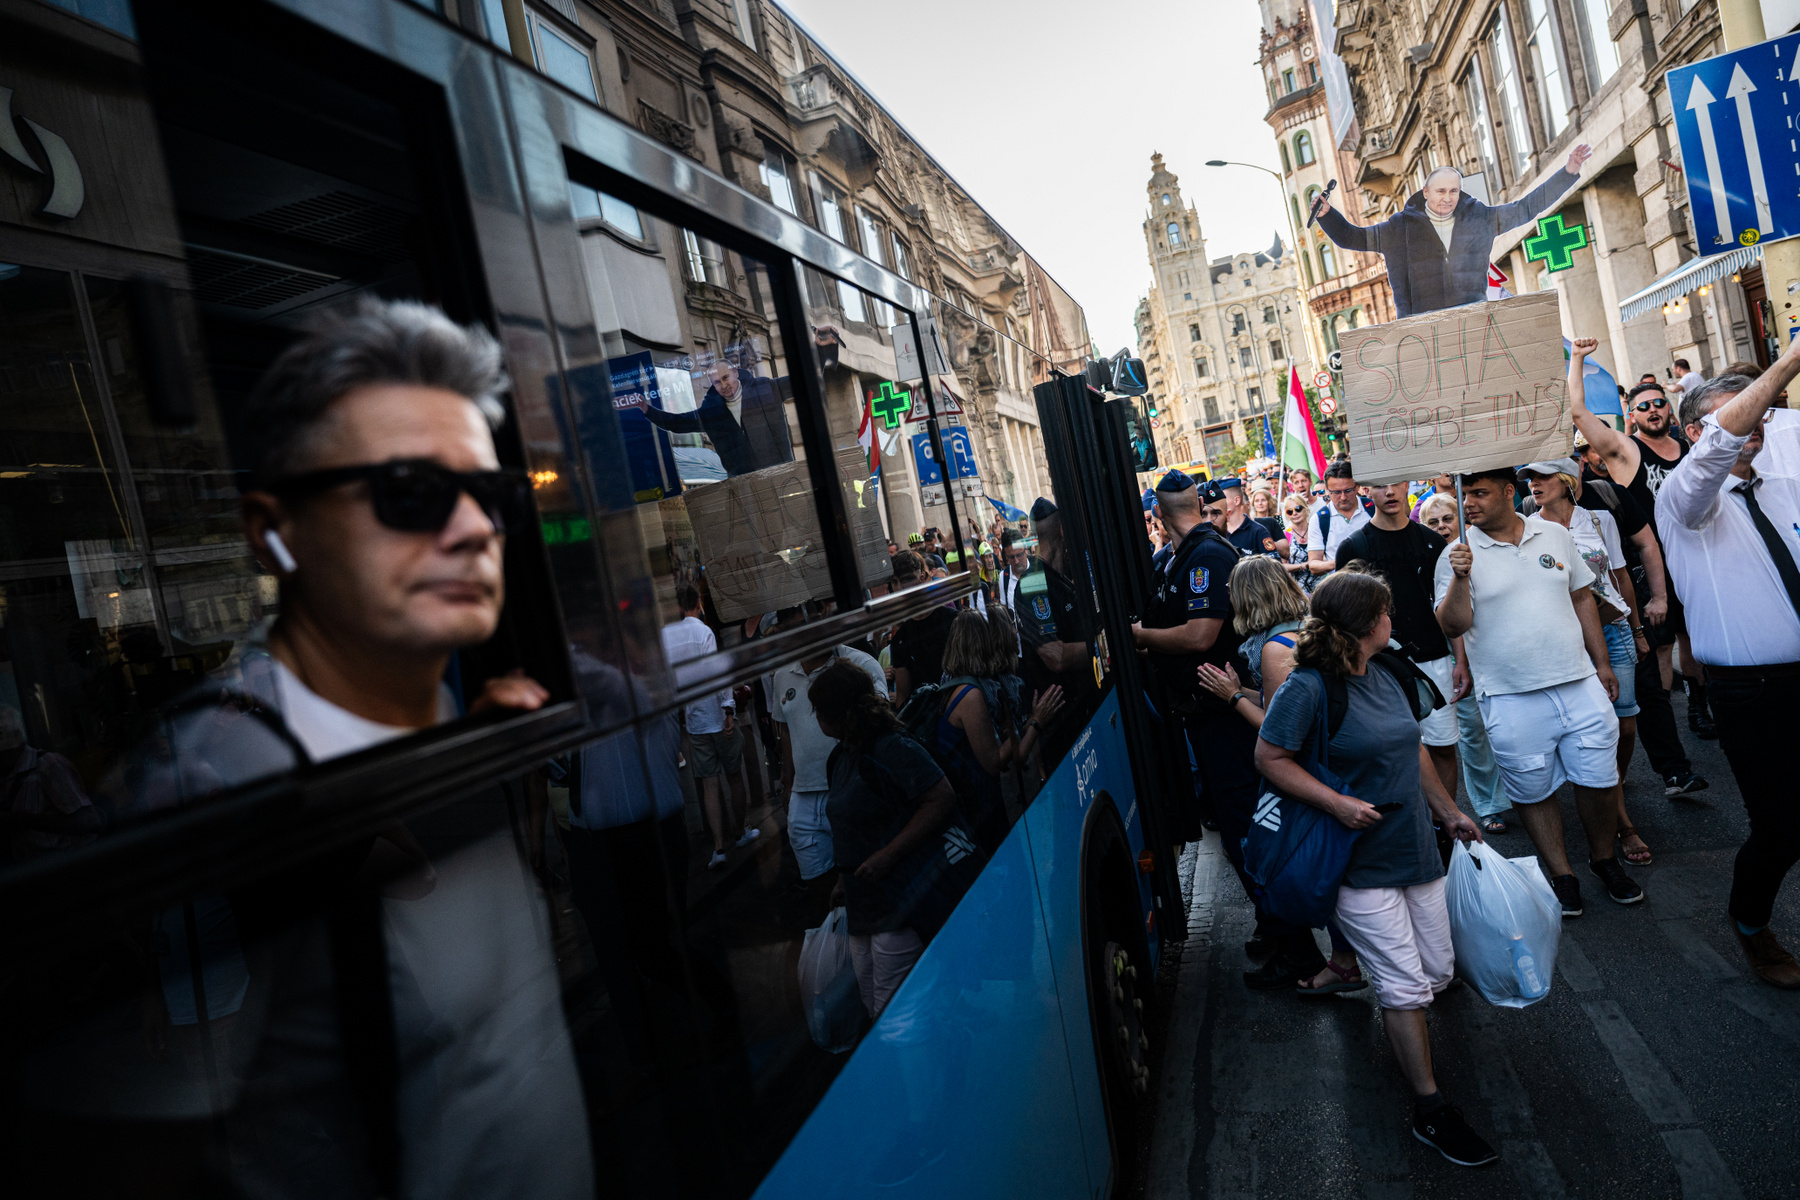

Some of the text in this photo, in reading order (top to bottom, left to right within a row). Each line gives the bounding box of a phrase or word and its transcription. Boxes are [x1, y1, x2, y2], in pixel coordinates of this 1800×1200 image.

[1355, 313, 1526, 406] SOHA
[643, 387, 671, 401] tere
[672, 381, 685, 394] M
